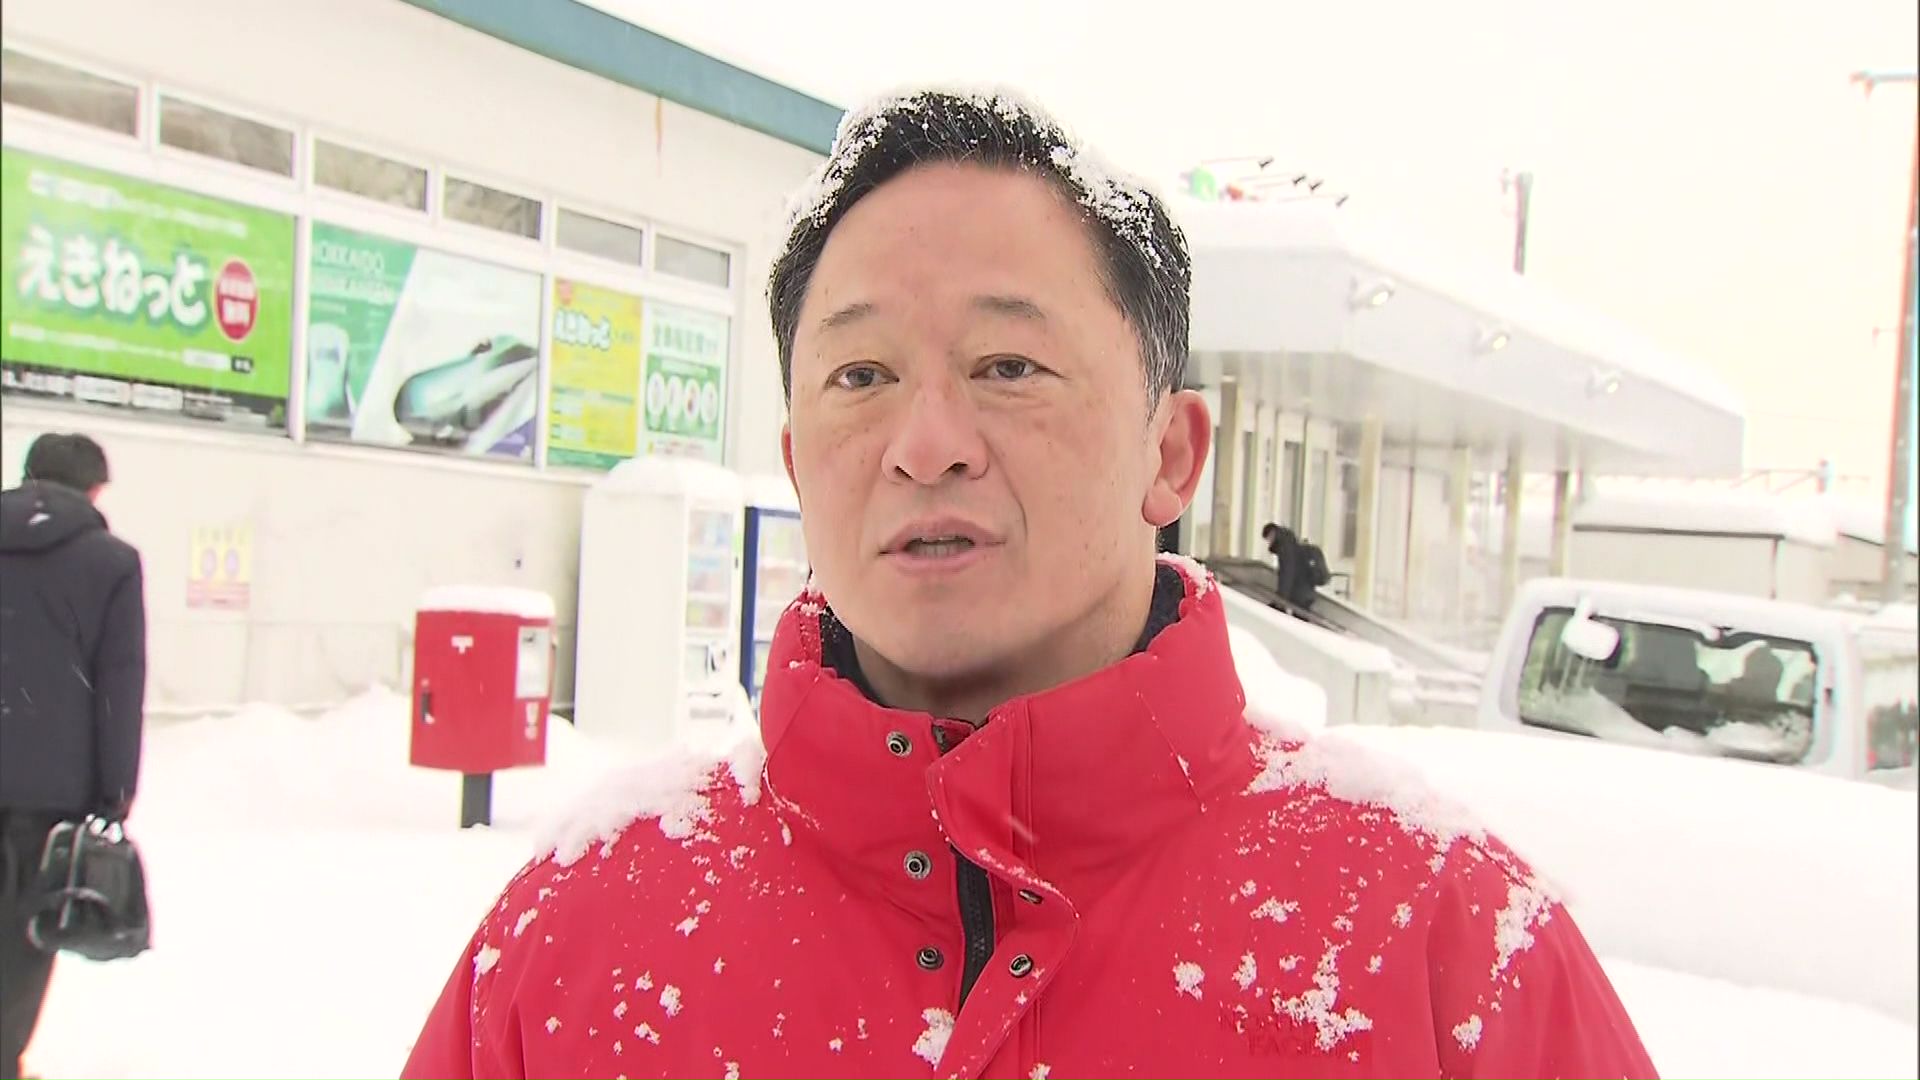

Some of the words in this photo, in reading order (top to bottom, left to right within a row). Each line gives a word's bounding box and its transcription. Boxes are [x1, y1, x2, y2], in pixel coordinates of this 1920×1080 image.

[18, 222, 208, 327] えきねっと
